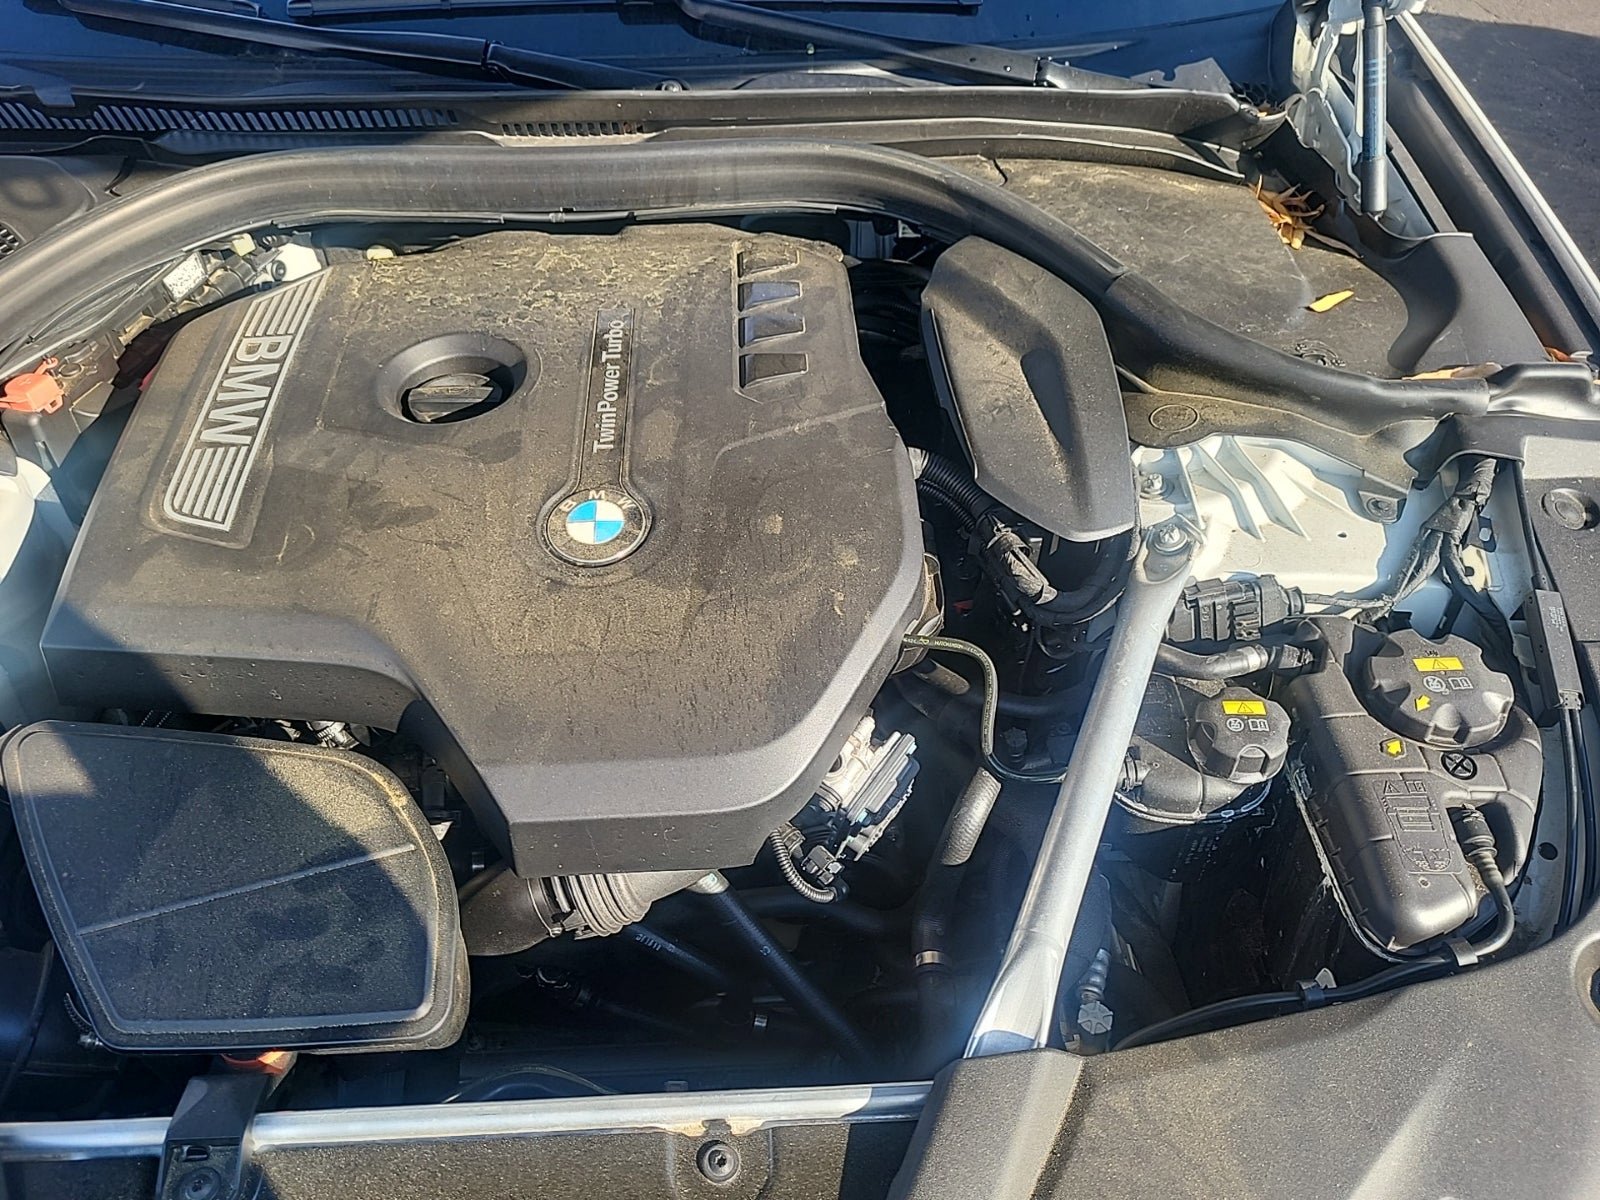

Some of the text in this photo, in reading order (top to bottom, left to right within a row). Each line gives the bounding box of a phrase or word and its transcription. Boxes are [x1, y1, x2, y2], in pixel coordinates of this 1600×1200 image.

[200, 334, 293, 446] BMW
[592, 319, 624, 454] TwinPower Turbo
[558, 489, 637, 513] BMW
